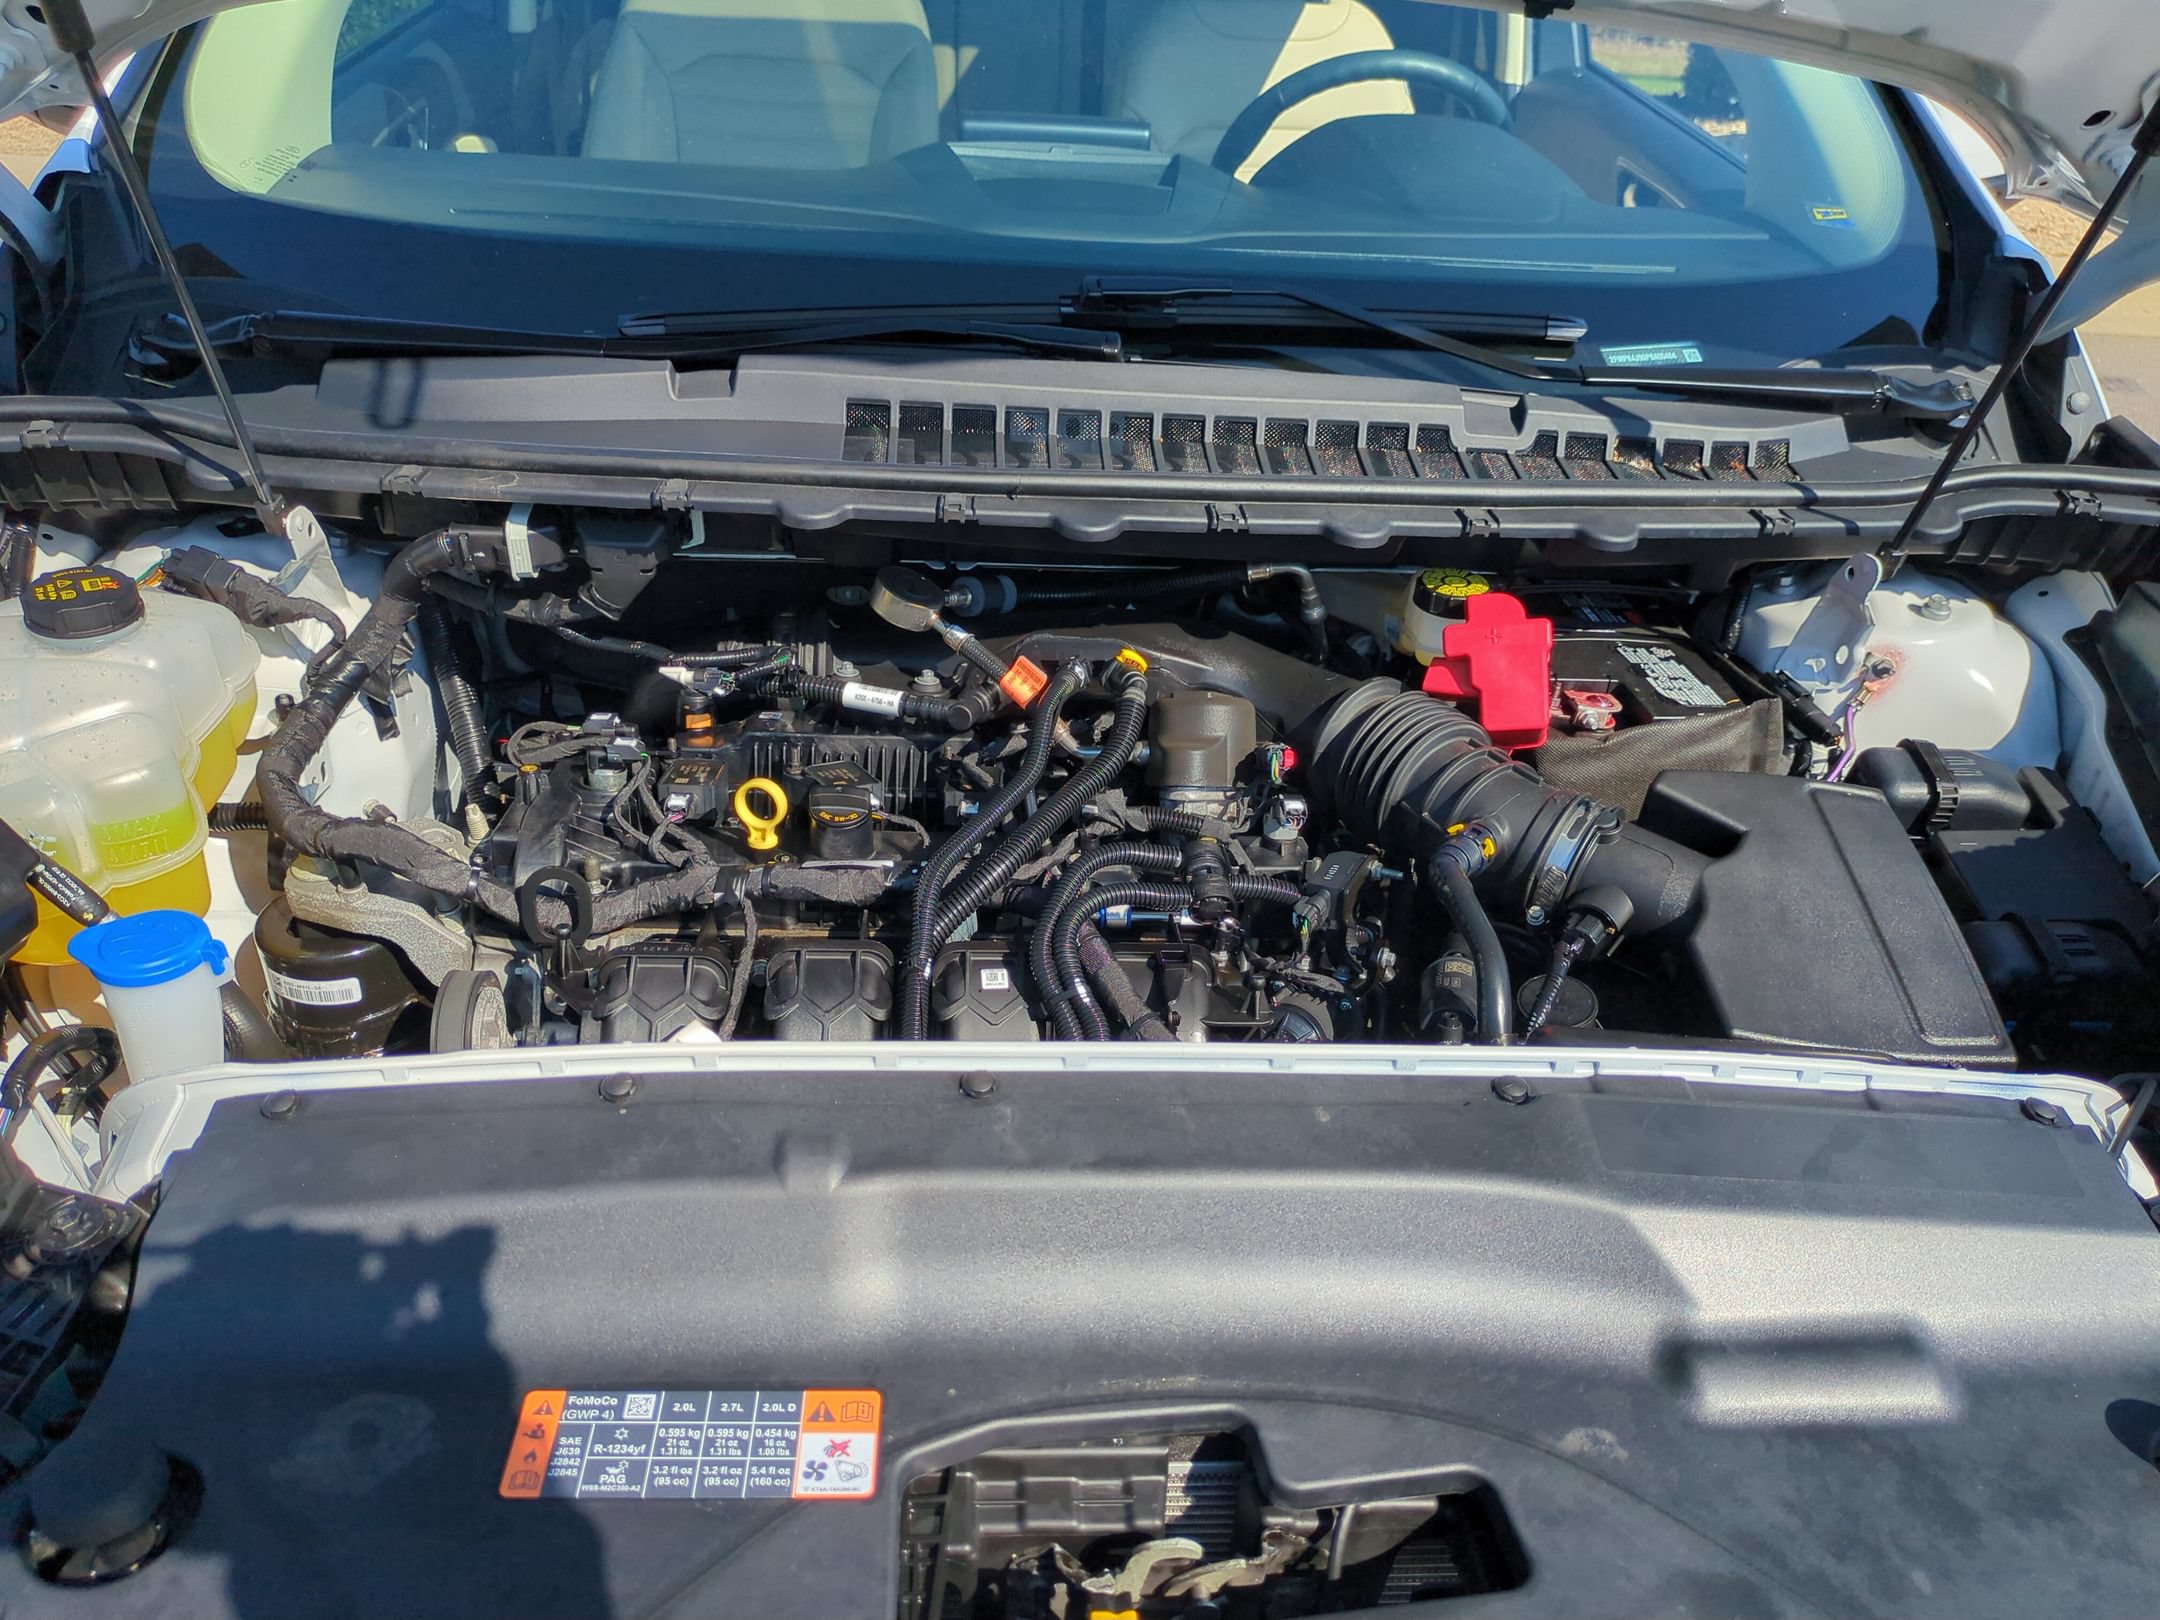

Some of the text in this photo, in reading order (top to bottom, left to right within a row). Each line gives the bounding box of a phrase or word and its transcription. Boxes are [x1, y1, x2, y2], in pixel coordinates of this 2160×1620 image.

[568, 1396, 618, 1405] FoMoCo
[672, 1403, 696, 1412] 2.0L
[720, 1403, 744, 1412] 2.7L
[762, 1403, 797, 1412] 2.0L D
[562, 1409, 615, 1421] (GWP 4)
[658, 1428, 701, 1440] 0.595 kg
[707, 1428, 749, 1440] 0.595 kg
[755, 1428, 797, 1440] 0.454 kg
[559, 1437, 582, 1445] SAE
[555, 1447, 580, 1455] J639
[594, 1443, 647, 1455] R-1234yf
[551, 1458, 581, 1466] J2842
[547, 1468, 578, 1476] J2845
[652, 1466, 669, 1474] 3.2
[670, 1466, 679, 1474] fl
[702, 1466, 718, 1474] 3.2
[720, 1466, 728, 1474] fl
[751, 1466, 765, 1474] 5.4
[766, 1466, 775, 1474] fl
[599, 1475, 626, 1484] PAG
[654, 1477, 689, 1487] (95 cc)
[704, 1477, 739, 1487] (95 cc)
[751, 1477, 790, 1487] (160 cc)
